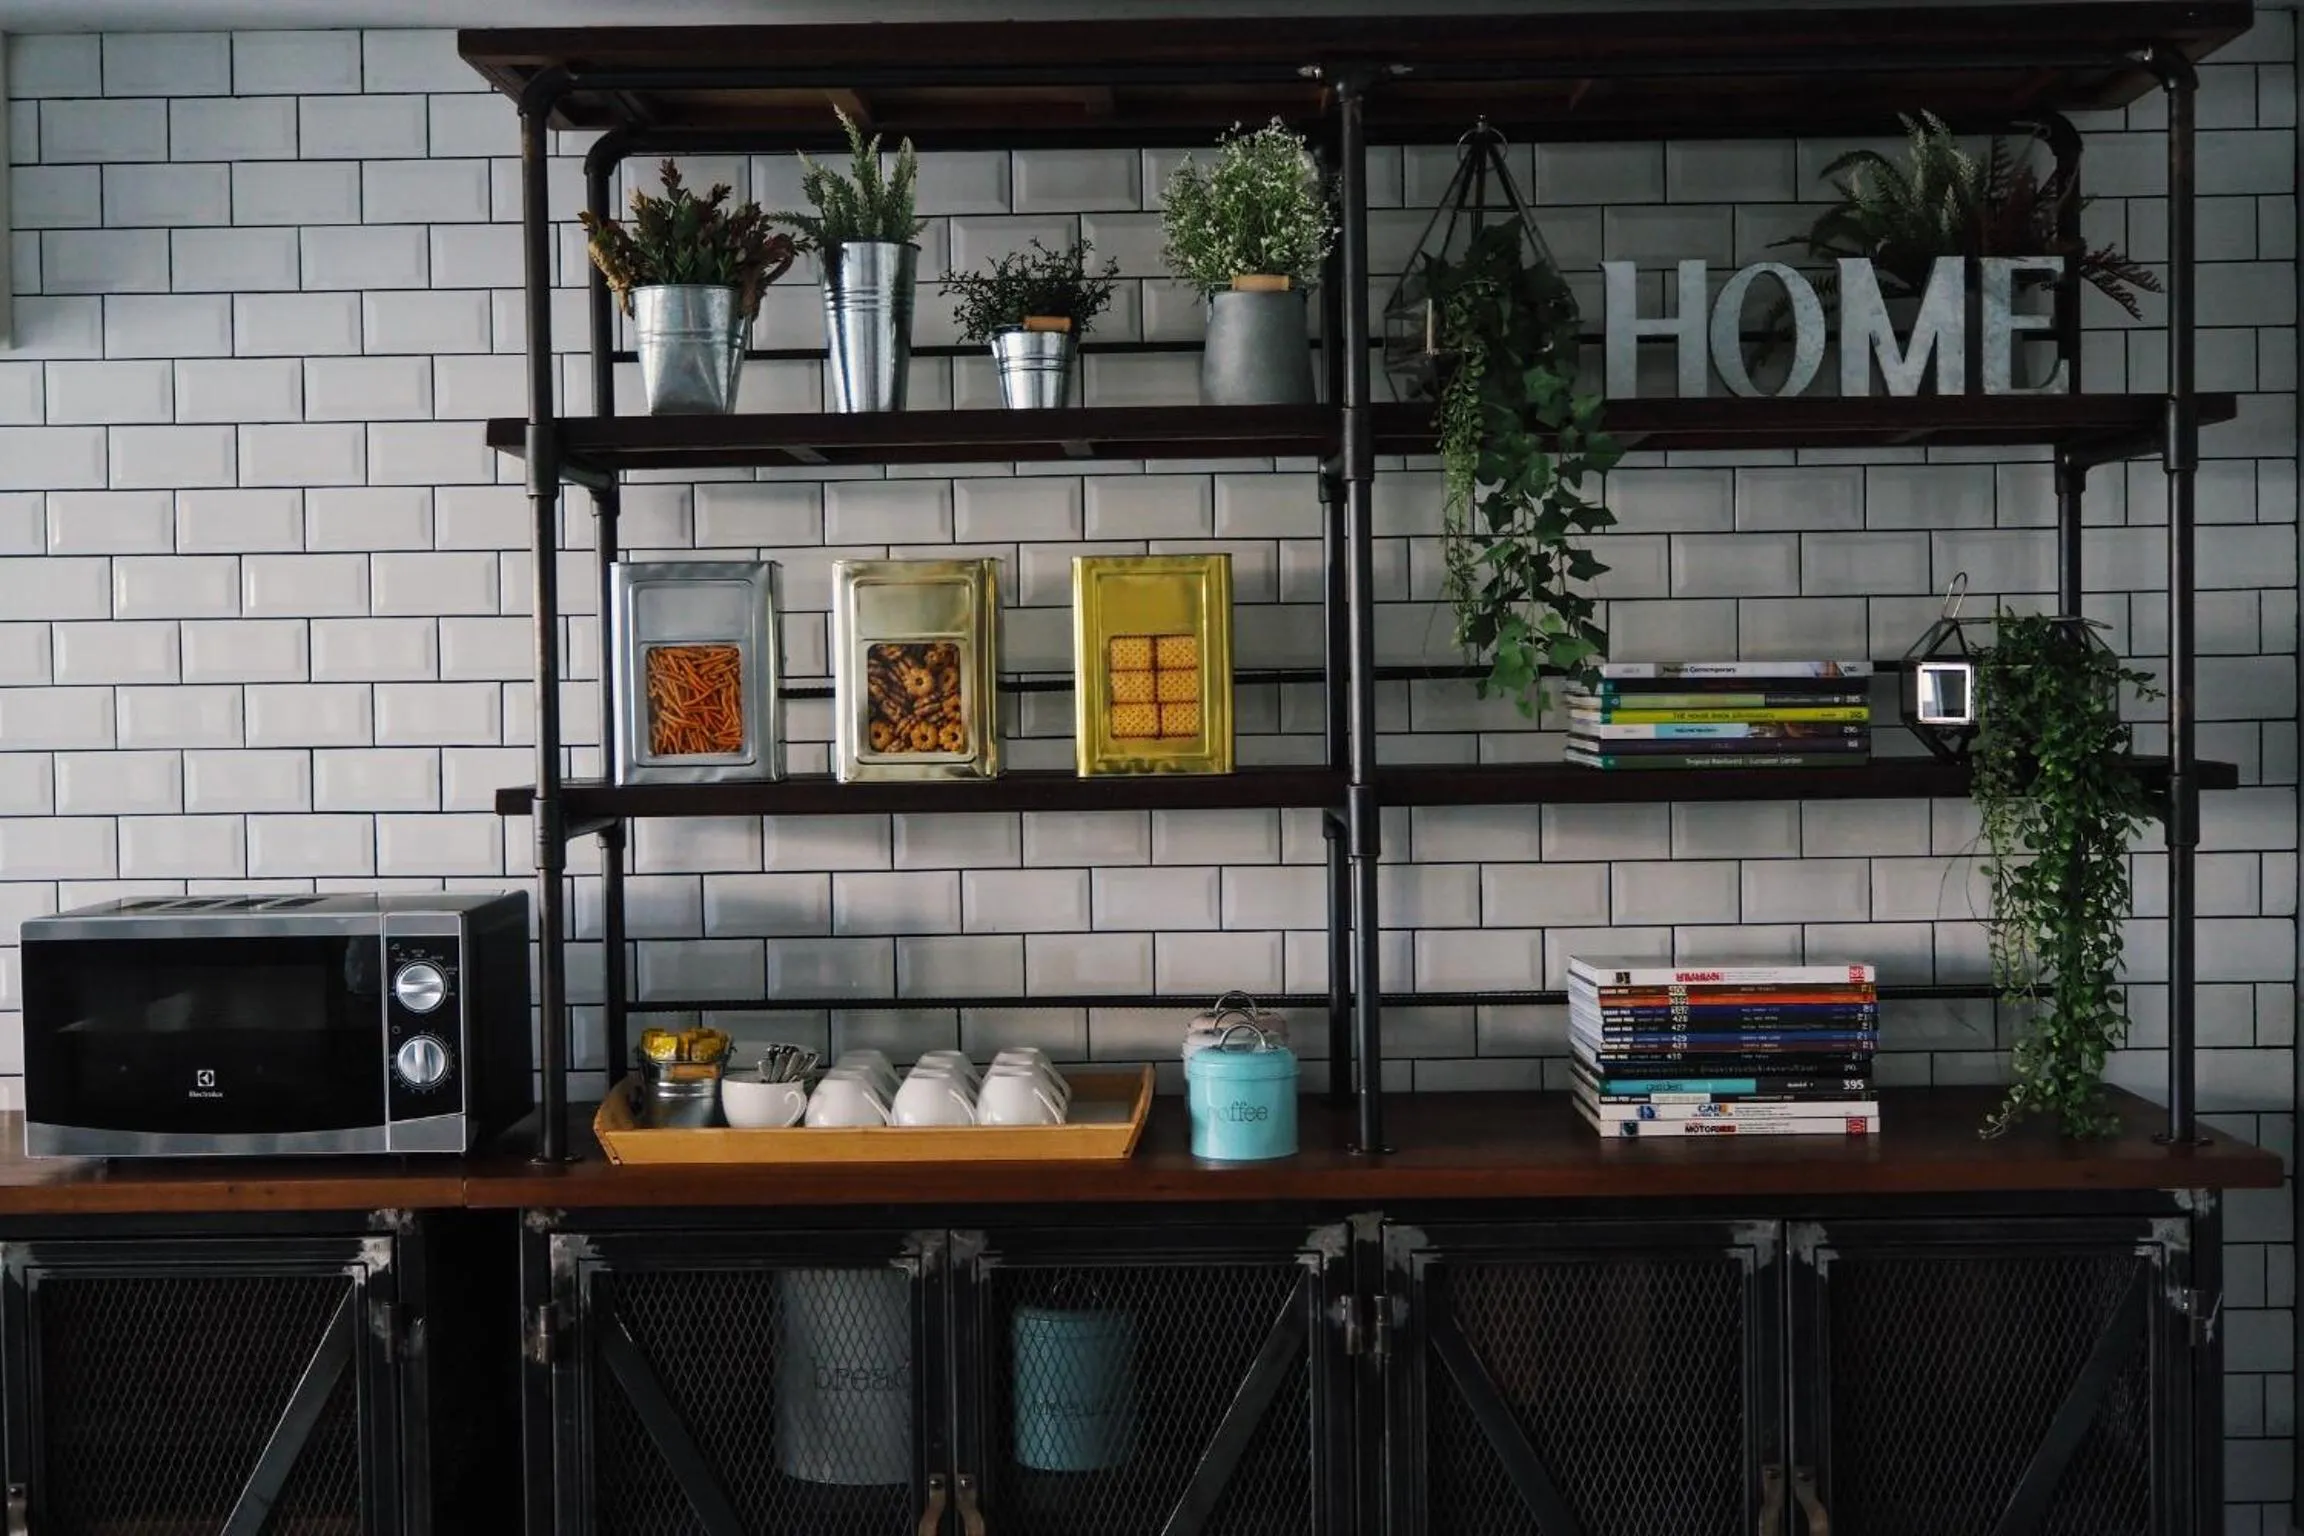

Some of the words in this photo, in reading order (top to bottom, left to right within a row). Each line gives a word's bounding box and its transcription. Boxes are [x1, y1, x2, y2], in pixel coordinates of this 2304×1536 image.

[1599, 256, 2069, 399] HOME
[1842, 1079, 1864, 1090] 395
[1206, 1101, 1268, 1122] coffee
